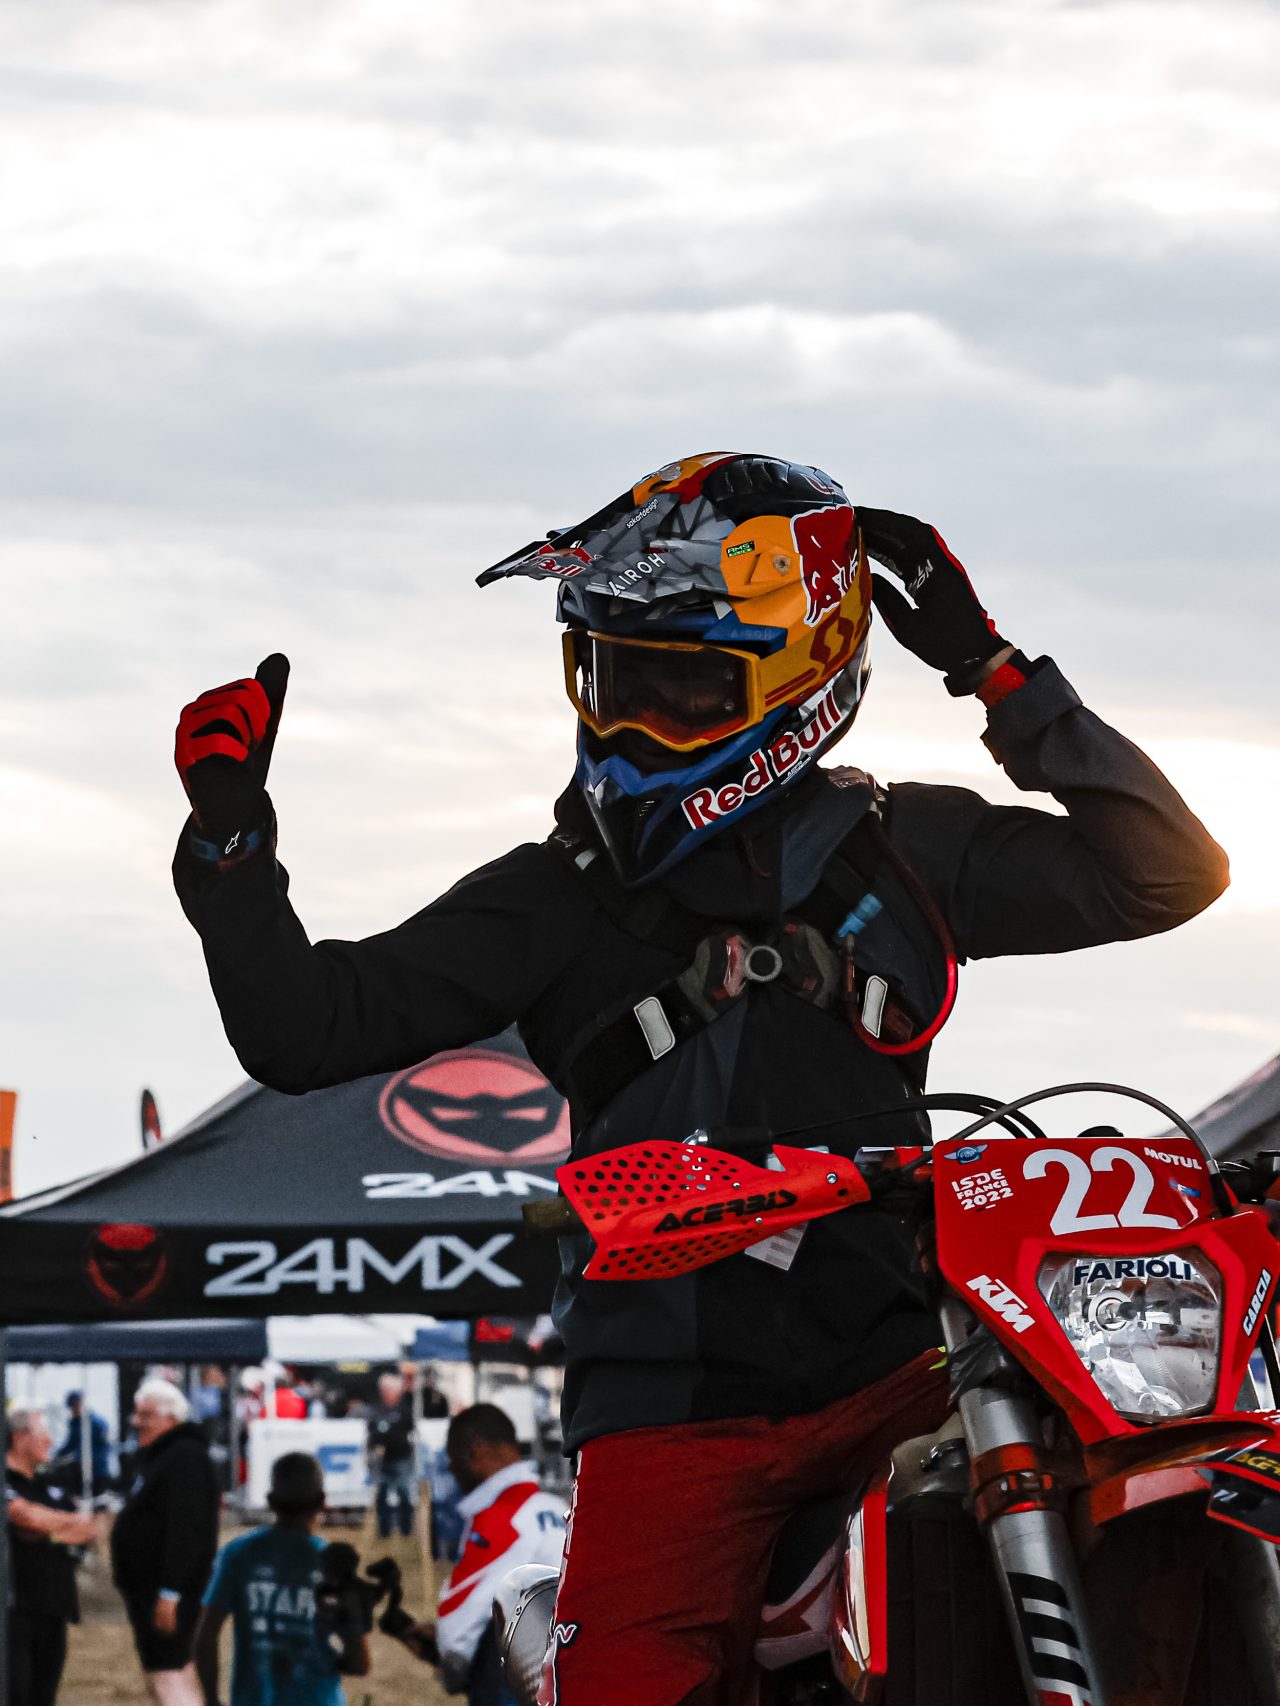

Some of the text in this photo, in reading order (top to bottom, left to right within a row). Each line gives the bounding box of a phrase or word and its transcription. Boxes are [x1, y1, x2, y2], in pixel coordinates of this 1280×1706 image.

[608, 552, 665, 597] AIROH
[681, 687, 846, 831] Red Bull
[951, 1167, 1006, 1190] ISDE
[1143, 1146, 1202, 1170] MOTUL
[652, 1189, 798, 1234] ACERBIS
[956, 1179, 1010, 1201] FRANCE
[960, 1187, 1014, 1211] 2022
[1022, 1146, 1180, 1236] 22
[203, 1233, 524, 1298] 24MX
[1073, 1259, 1192, 1287] FARIOLI
[966, 1275, 1036, 1334] KTM
[1242, 1267, 1272, 1337] GARCIA
